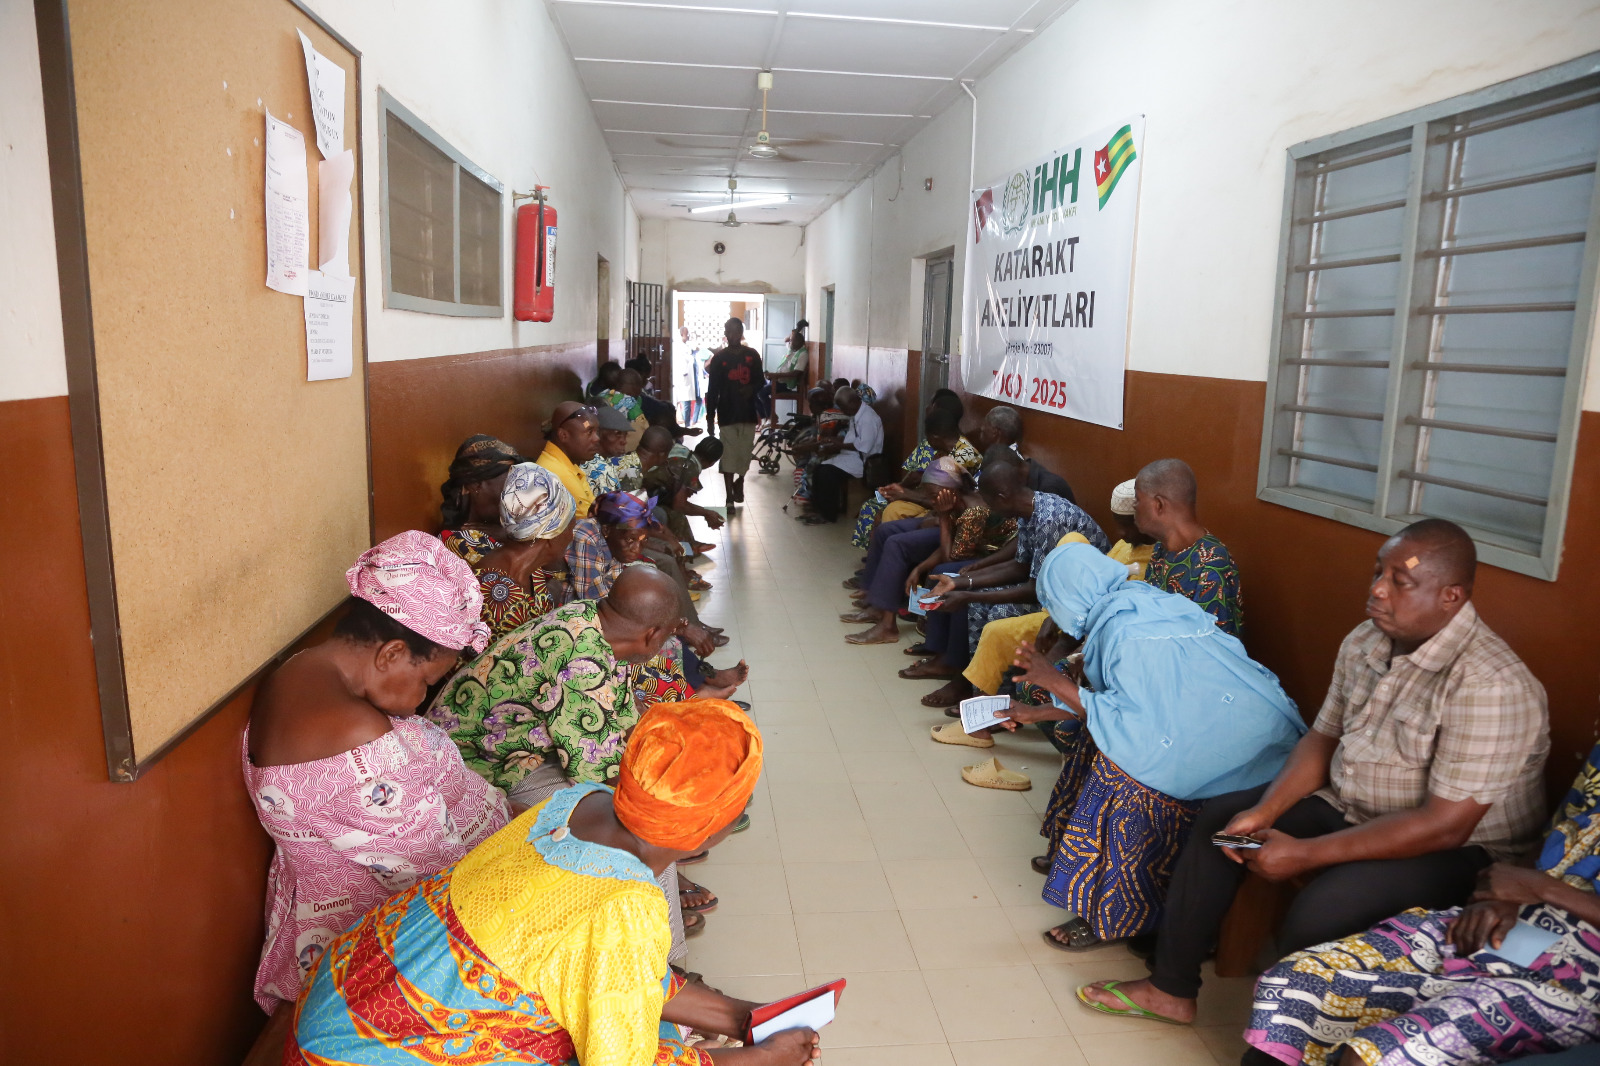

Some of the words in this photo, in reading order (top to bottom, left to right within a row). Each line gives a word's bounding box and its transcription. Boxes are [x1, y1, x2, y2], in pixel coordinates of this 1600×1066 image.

[994, 236, 1079, 282] KATARAKT
[1030, 377, 1067, 409] 2025
[351, 747, 367, 775] Gloire
